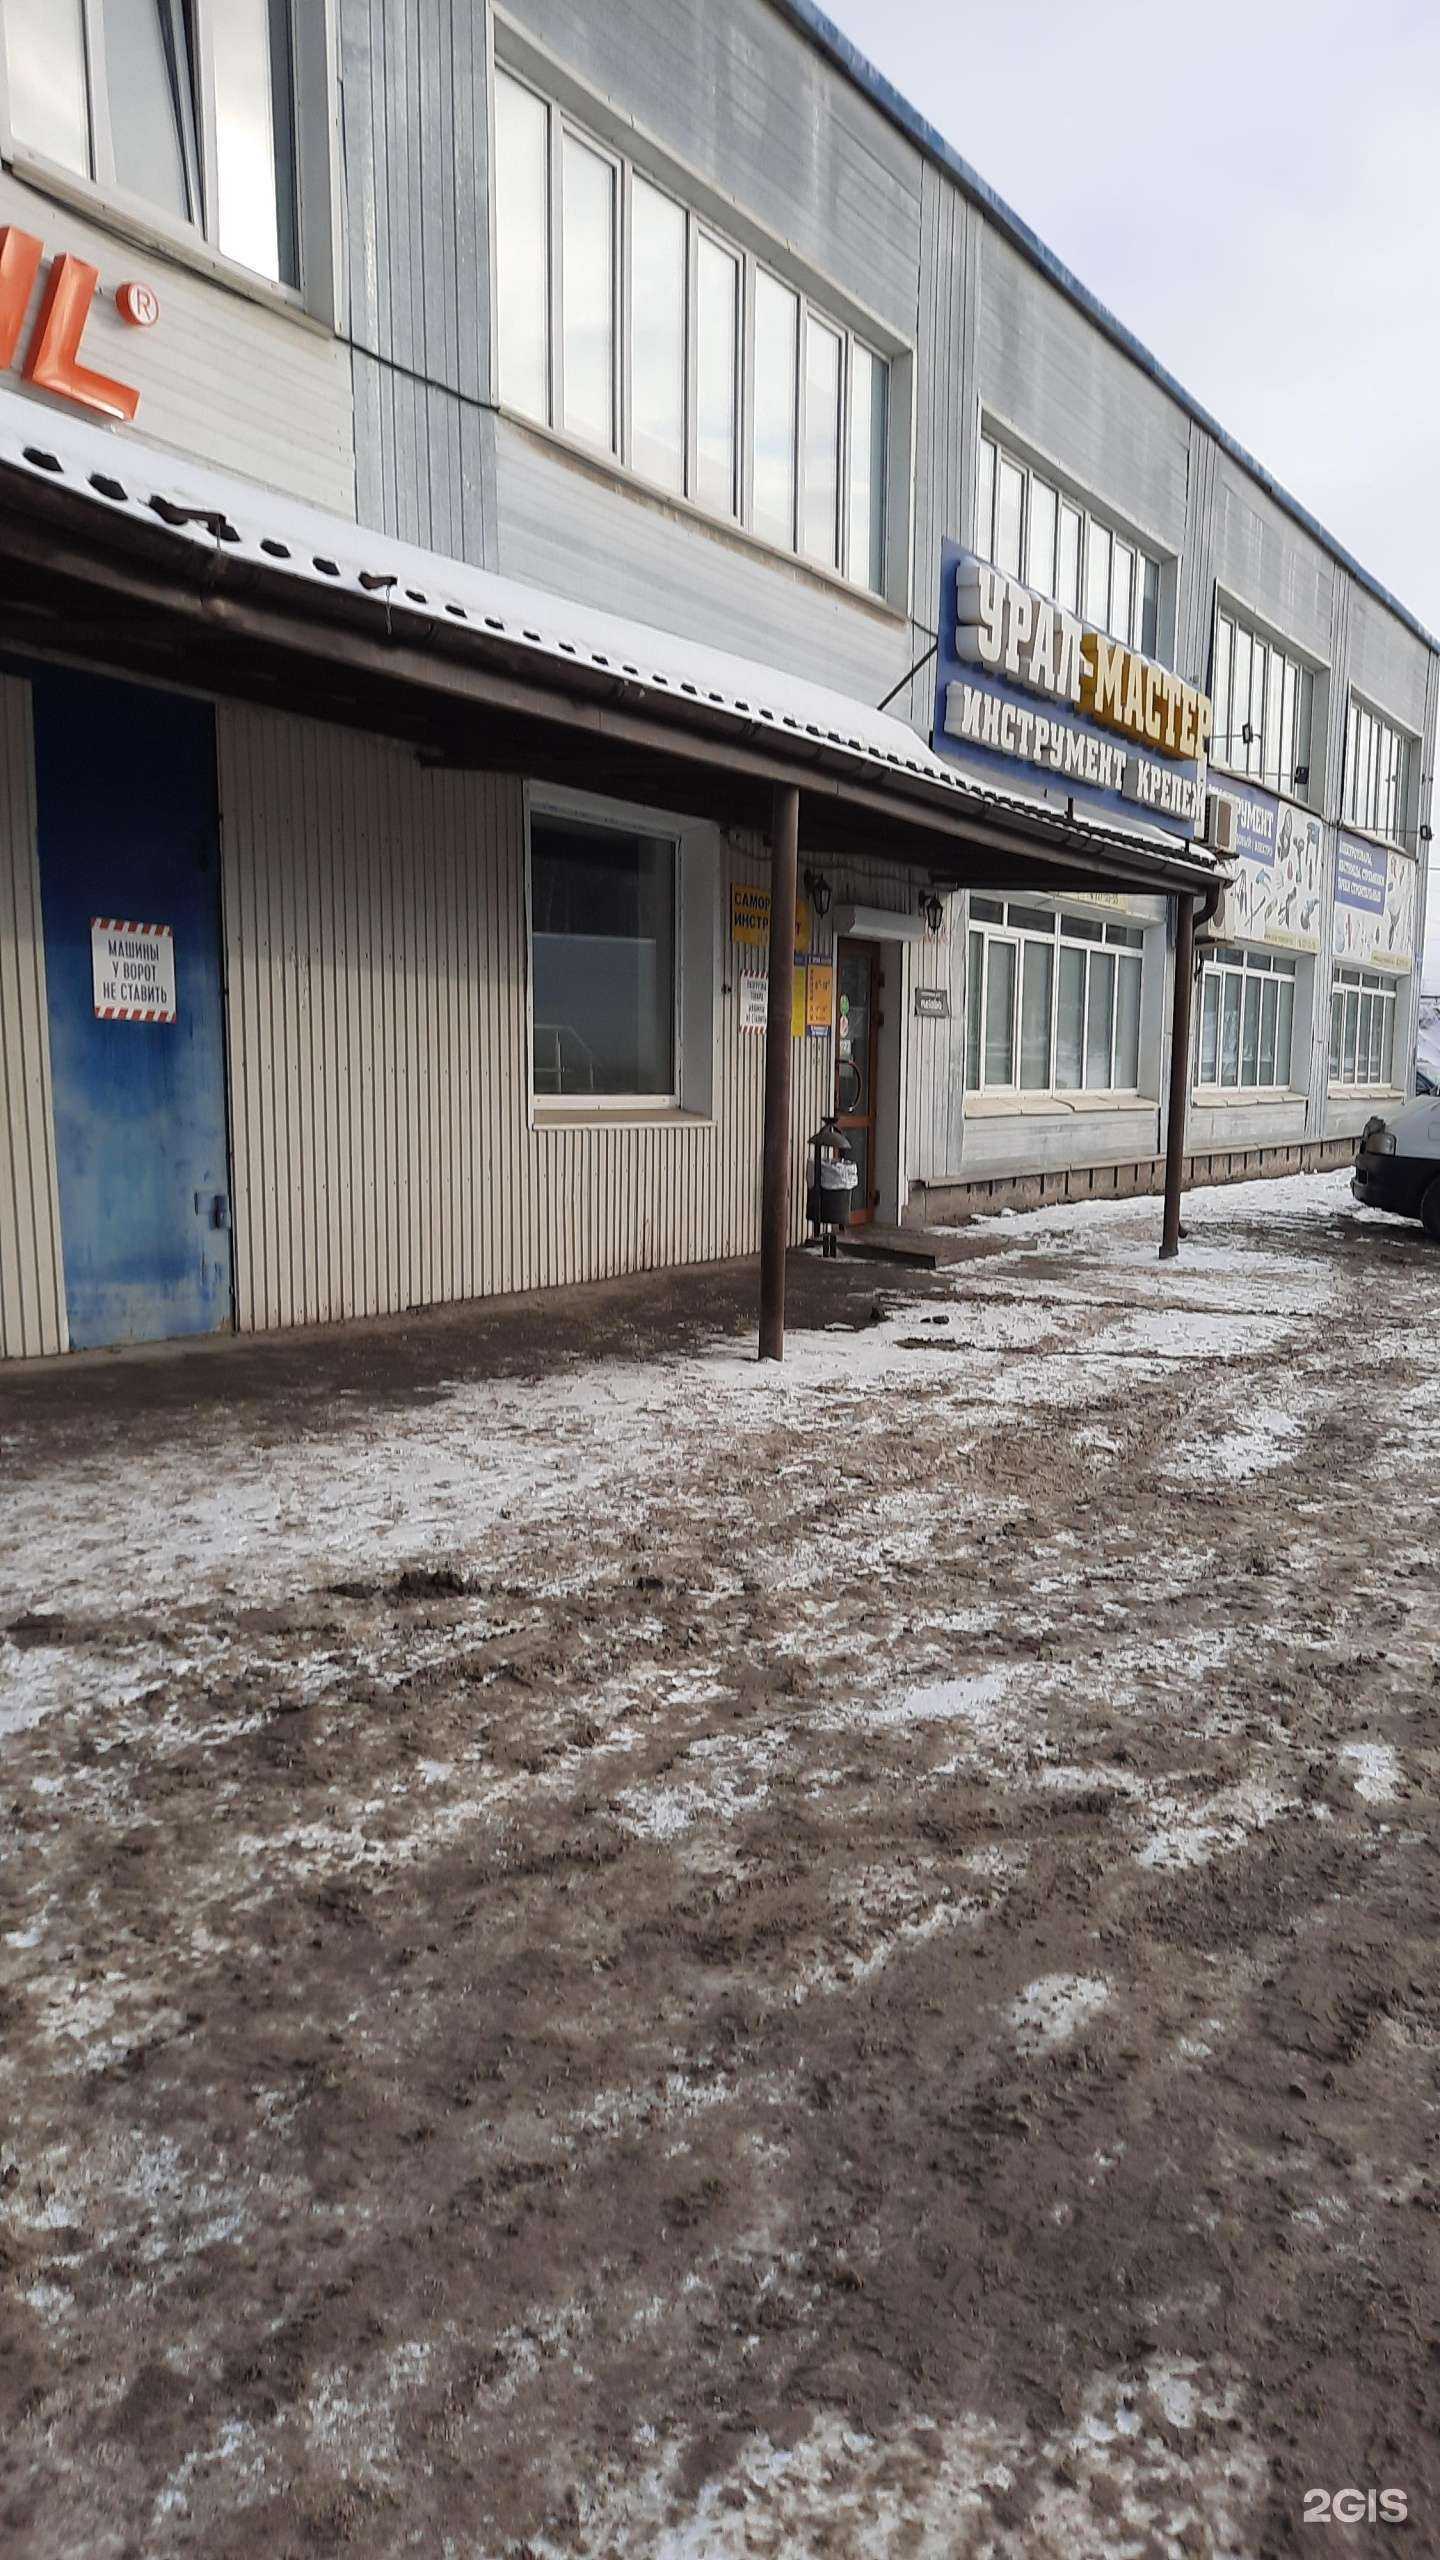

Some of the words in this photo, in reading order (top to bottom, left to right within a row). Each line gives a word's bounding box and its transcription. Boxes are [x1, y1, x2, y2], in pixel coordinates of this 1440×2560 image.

[976, 562, 1213, 763] УРАЛ-МАСТЕР
[960, 682, 1128, 791] ИНСТРУМЕНТ
[1135, 757, 1206, 823] КРЕПЕЖ
[107, 939, 160, 961] МАШИНЫ
[112, 961, 119, 978] У
[123, 962, 157, 982] ВОРОТ
[103, 981, 117, 999] НЕ
[120, 982, 168, 1004] СТАВИТЬ
